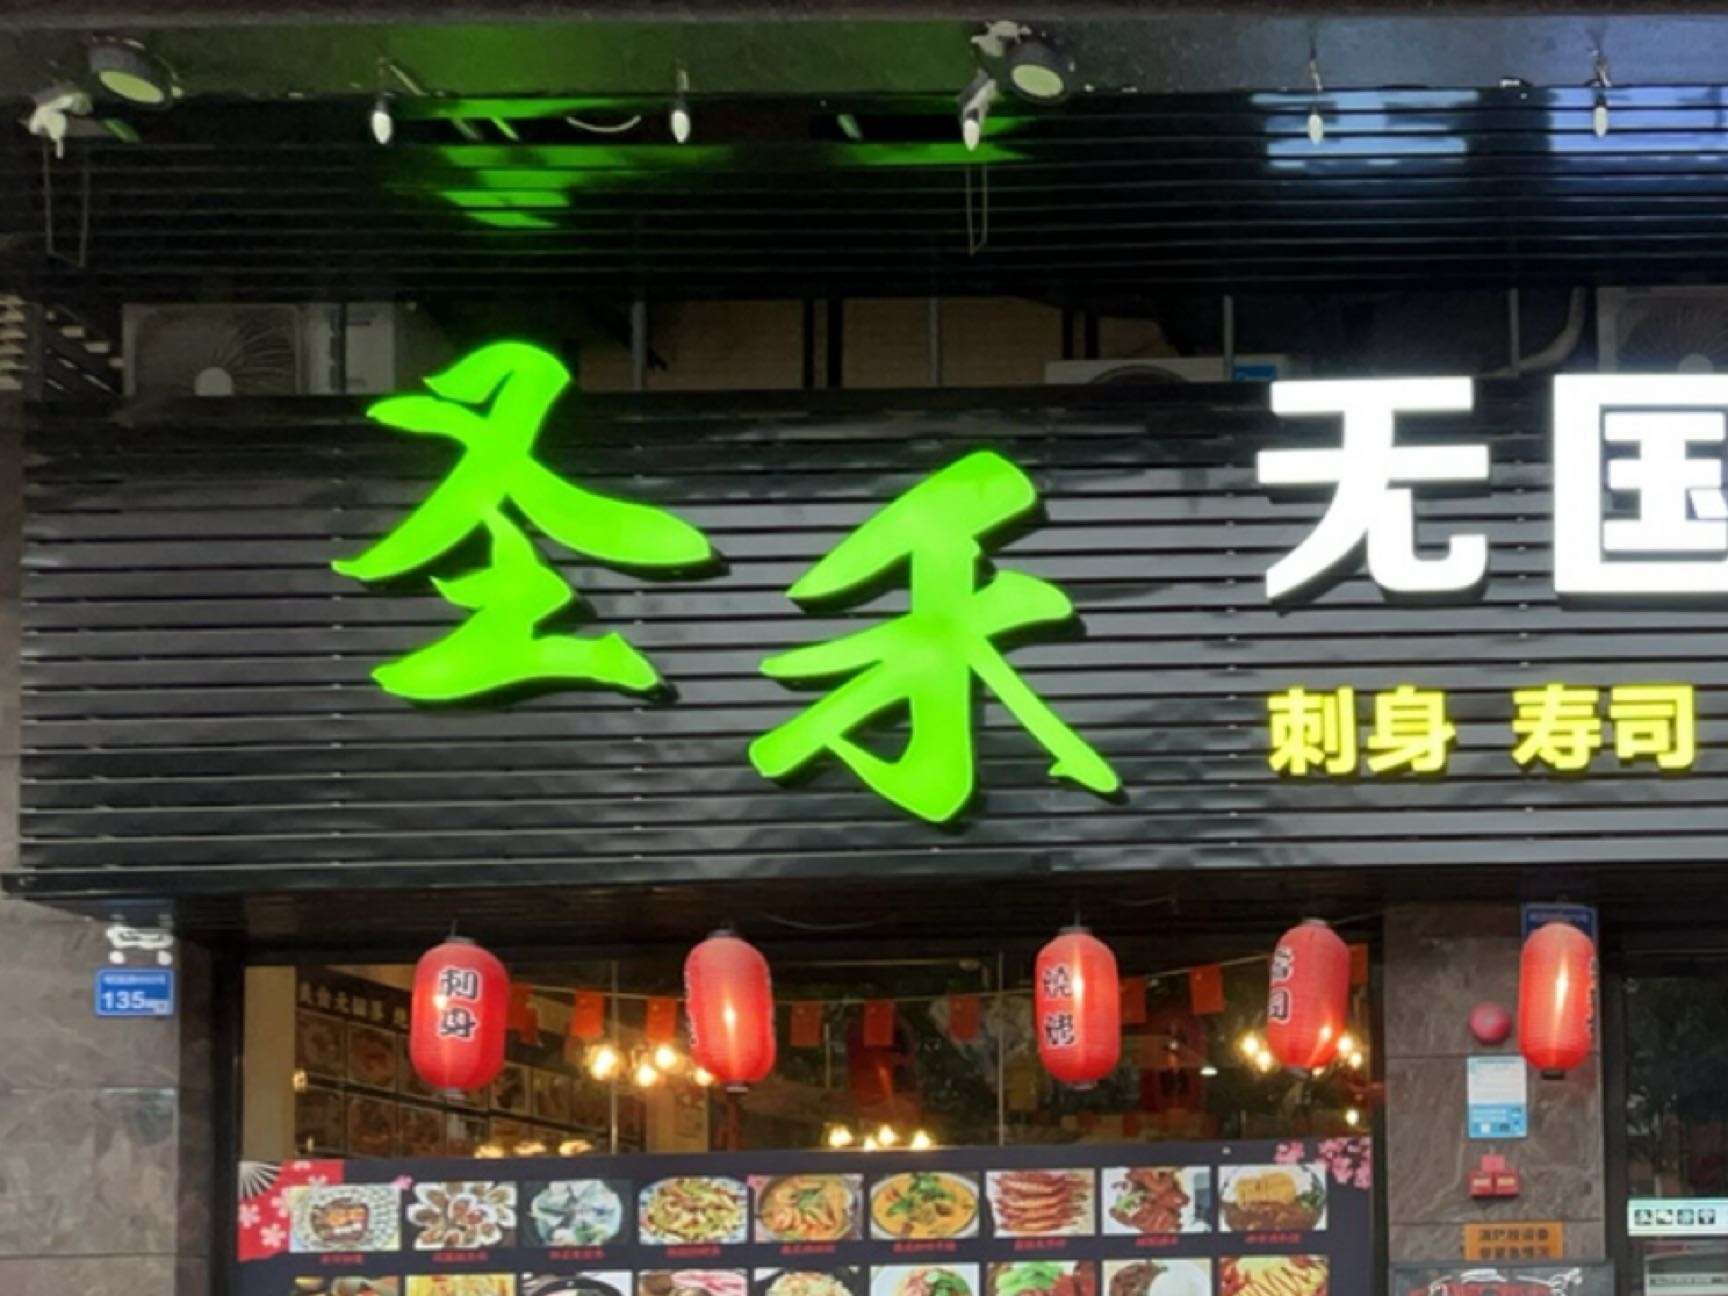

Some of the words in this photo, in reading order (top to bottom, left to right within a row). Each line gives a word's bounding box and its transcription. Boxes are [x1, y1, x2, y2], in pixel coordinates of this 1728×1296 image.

[1267, 686, 1456, 776] 刺身
[1511, 684, 1697, 770] 寿司
[437, 967, 482, 1040] 刺身
